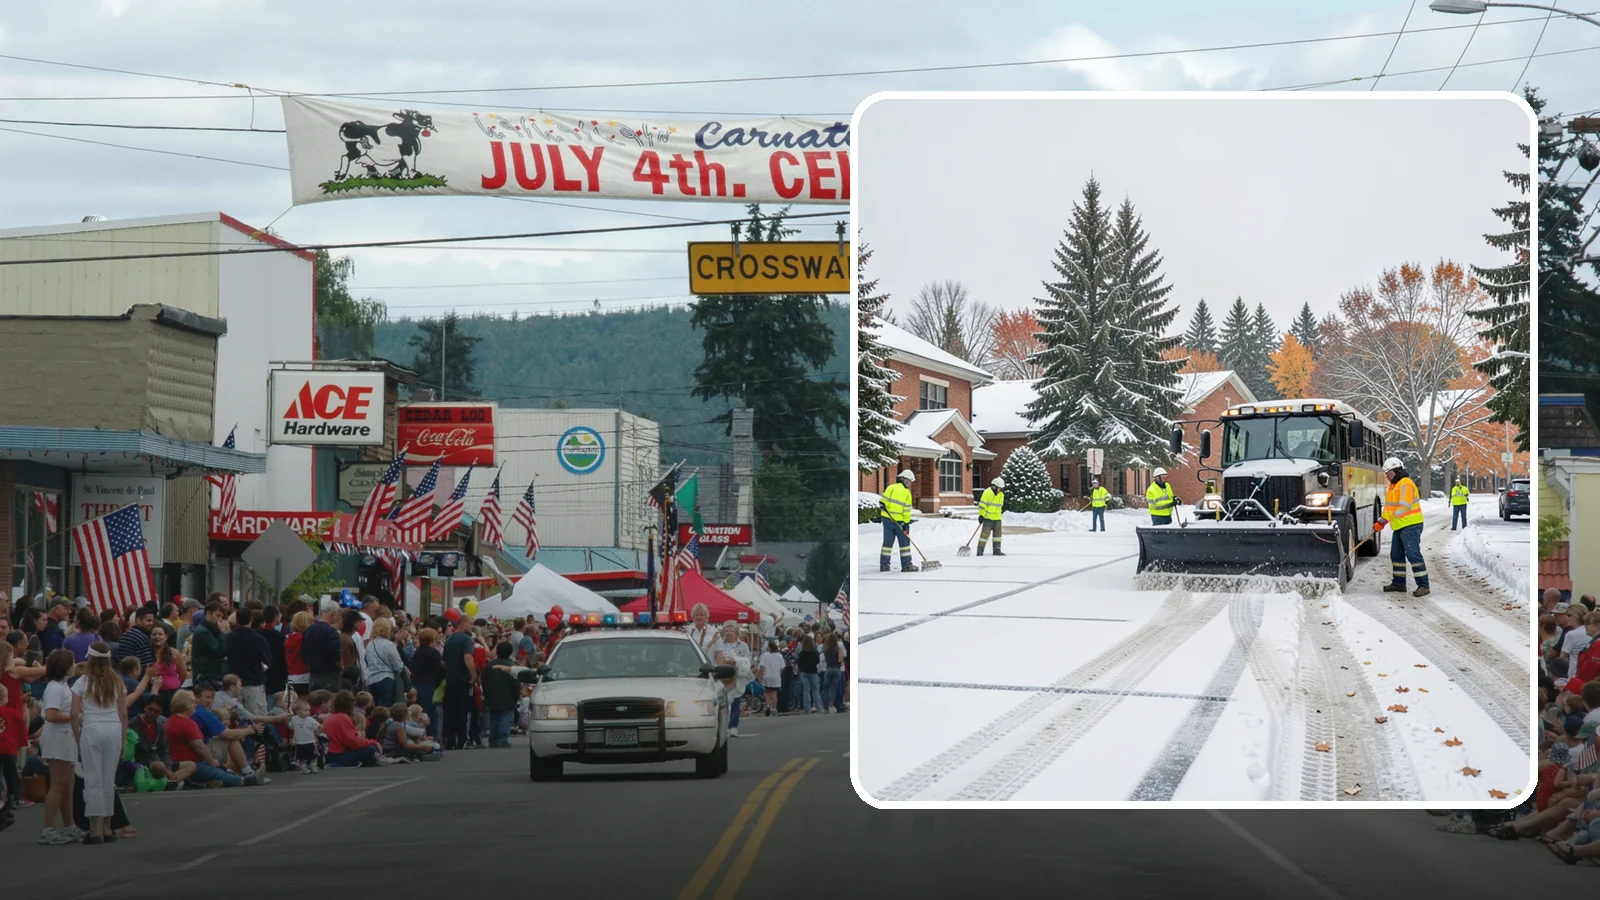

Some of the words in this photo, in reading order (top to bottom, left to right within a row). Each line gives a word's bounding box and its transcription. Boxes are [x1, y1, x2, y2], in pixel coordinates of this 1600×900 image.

[695, 121, 850, 150] Carnat
[481, 141, 605, 193] JULY
[632, 150, 746, 198] 4th.
[697, 254, 850, 280] CROSSWA
[282, 380, 373, 420] ACE
[406, 409, 452, 422] CEDAR
[283, 421, 371, 437] Hardware
[416, 428, 477, 447] Coca-Cola
[353, 467, 386, 481] Simpl
[96, 485, 124, 495] Vincent
[126, 486, 136, 495] de
[138, 486, 155, 495] Paul
[81, 503, 154, 522] THT
[688, 526, 741, 535] CRNATION
[699, 535, 730, 543] GLASS
